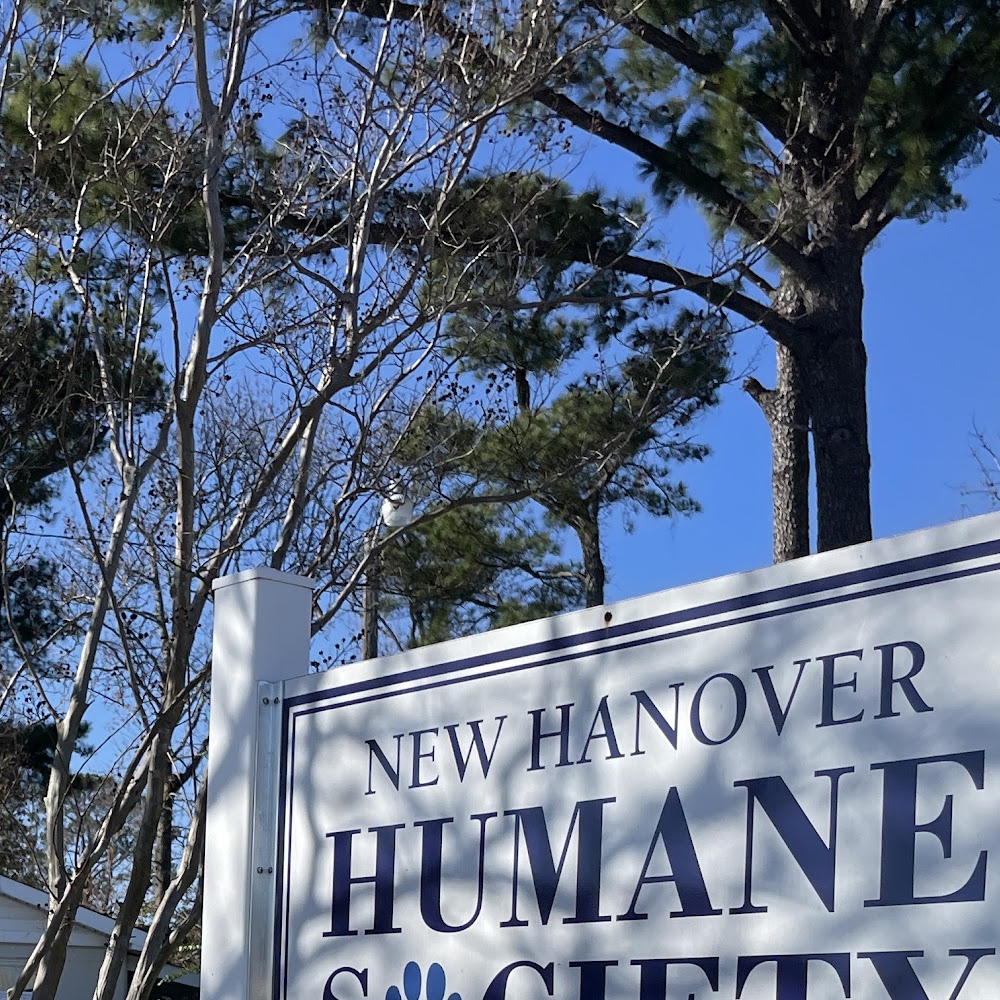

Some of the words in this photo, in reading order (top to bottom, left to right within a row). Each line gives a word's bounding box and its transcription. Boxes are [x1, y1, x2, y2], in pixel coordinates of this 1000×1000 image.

[364, 714, 508, 796] NEW
[527, 640, 934, 772] HANOVER
[322, 749, 989, 938] HUMANE
